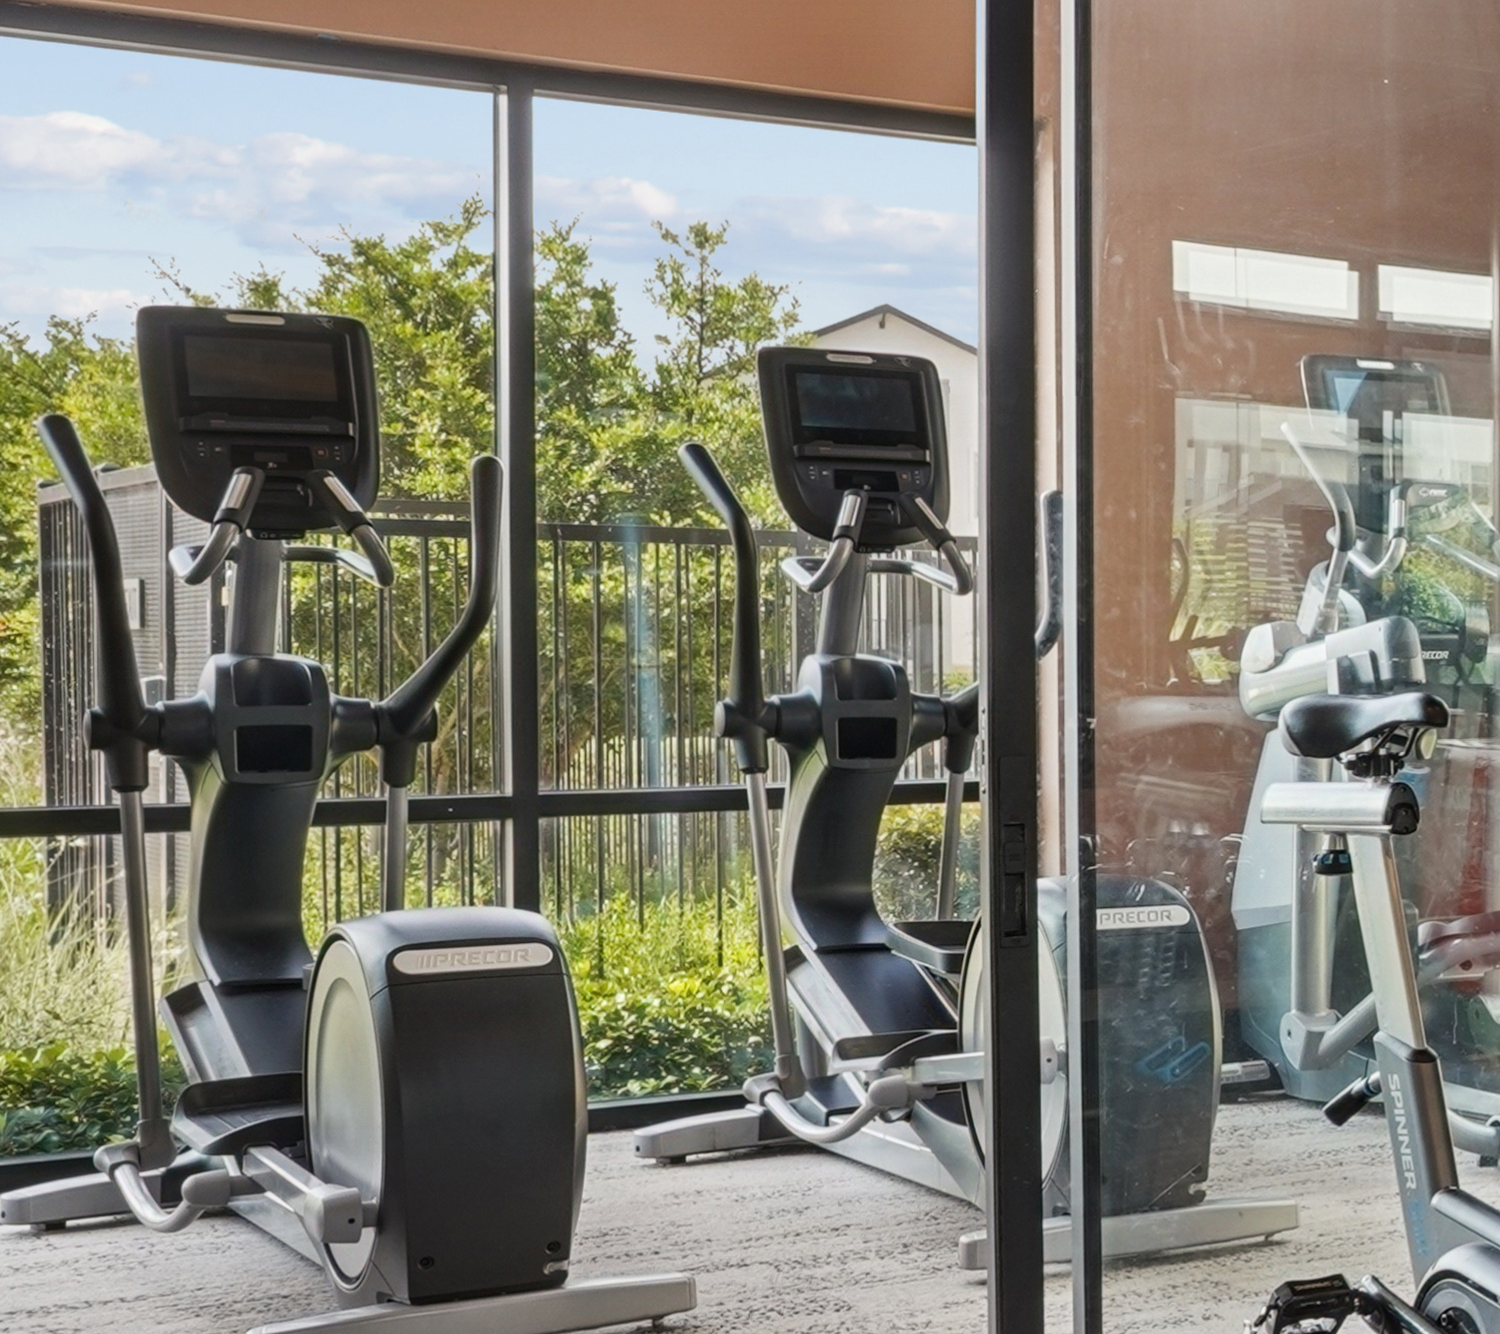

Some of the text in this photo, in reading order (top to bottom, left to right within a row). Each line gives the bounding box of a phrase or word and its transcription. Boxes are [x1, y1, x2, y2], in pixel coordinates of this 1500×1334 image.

[1421, 650, 1450, 660] RECOR
[428, 948, 532, 968] PRECOR
[1388, 1073, 1417, 1190] SPINNER
